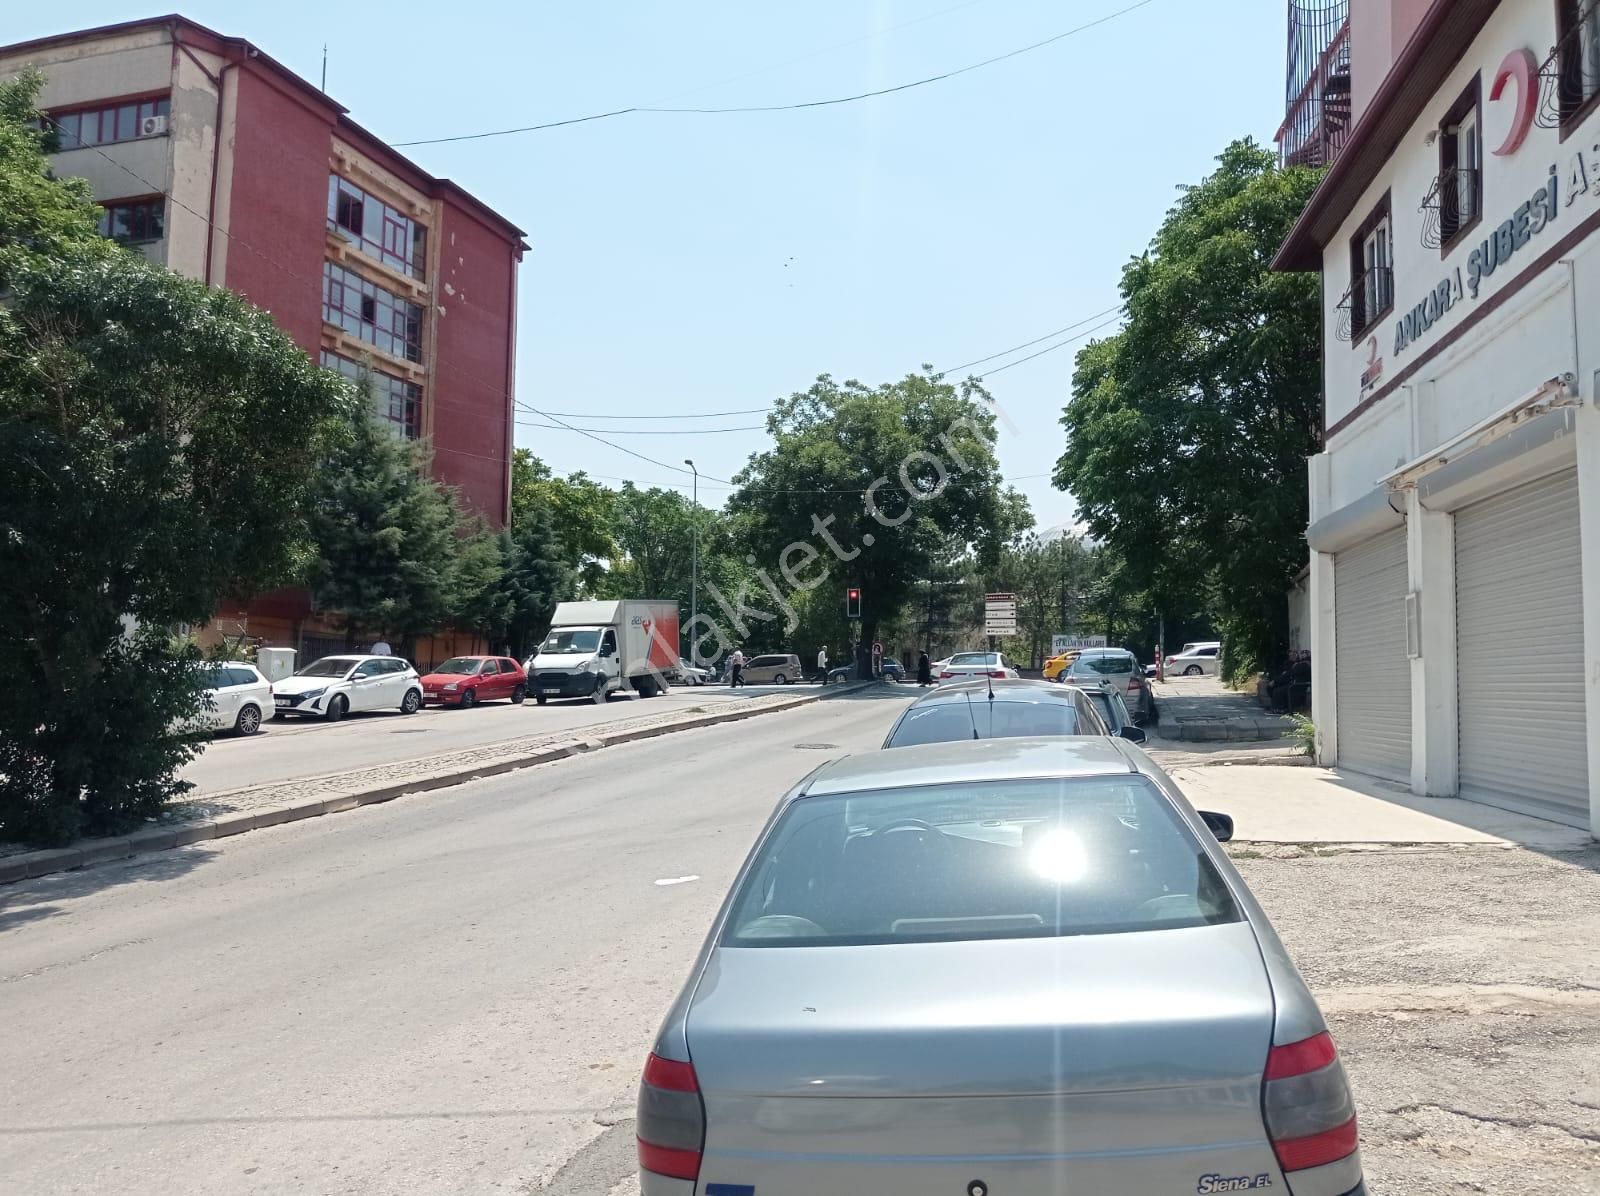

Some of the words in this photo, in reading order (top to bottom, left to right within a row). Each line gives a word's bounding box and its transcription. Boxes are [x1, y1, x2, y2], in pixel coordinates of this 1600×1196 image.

[1394, 267, 1463, 356] ANKARA
[1467, 164, 1558, 299] ŞUBESİ
[1198, 1174, 1249, 1194] Siena
[1256, 1175, 1272, 1187] EL
